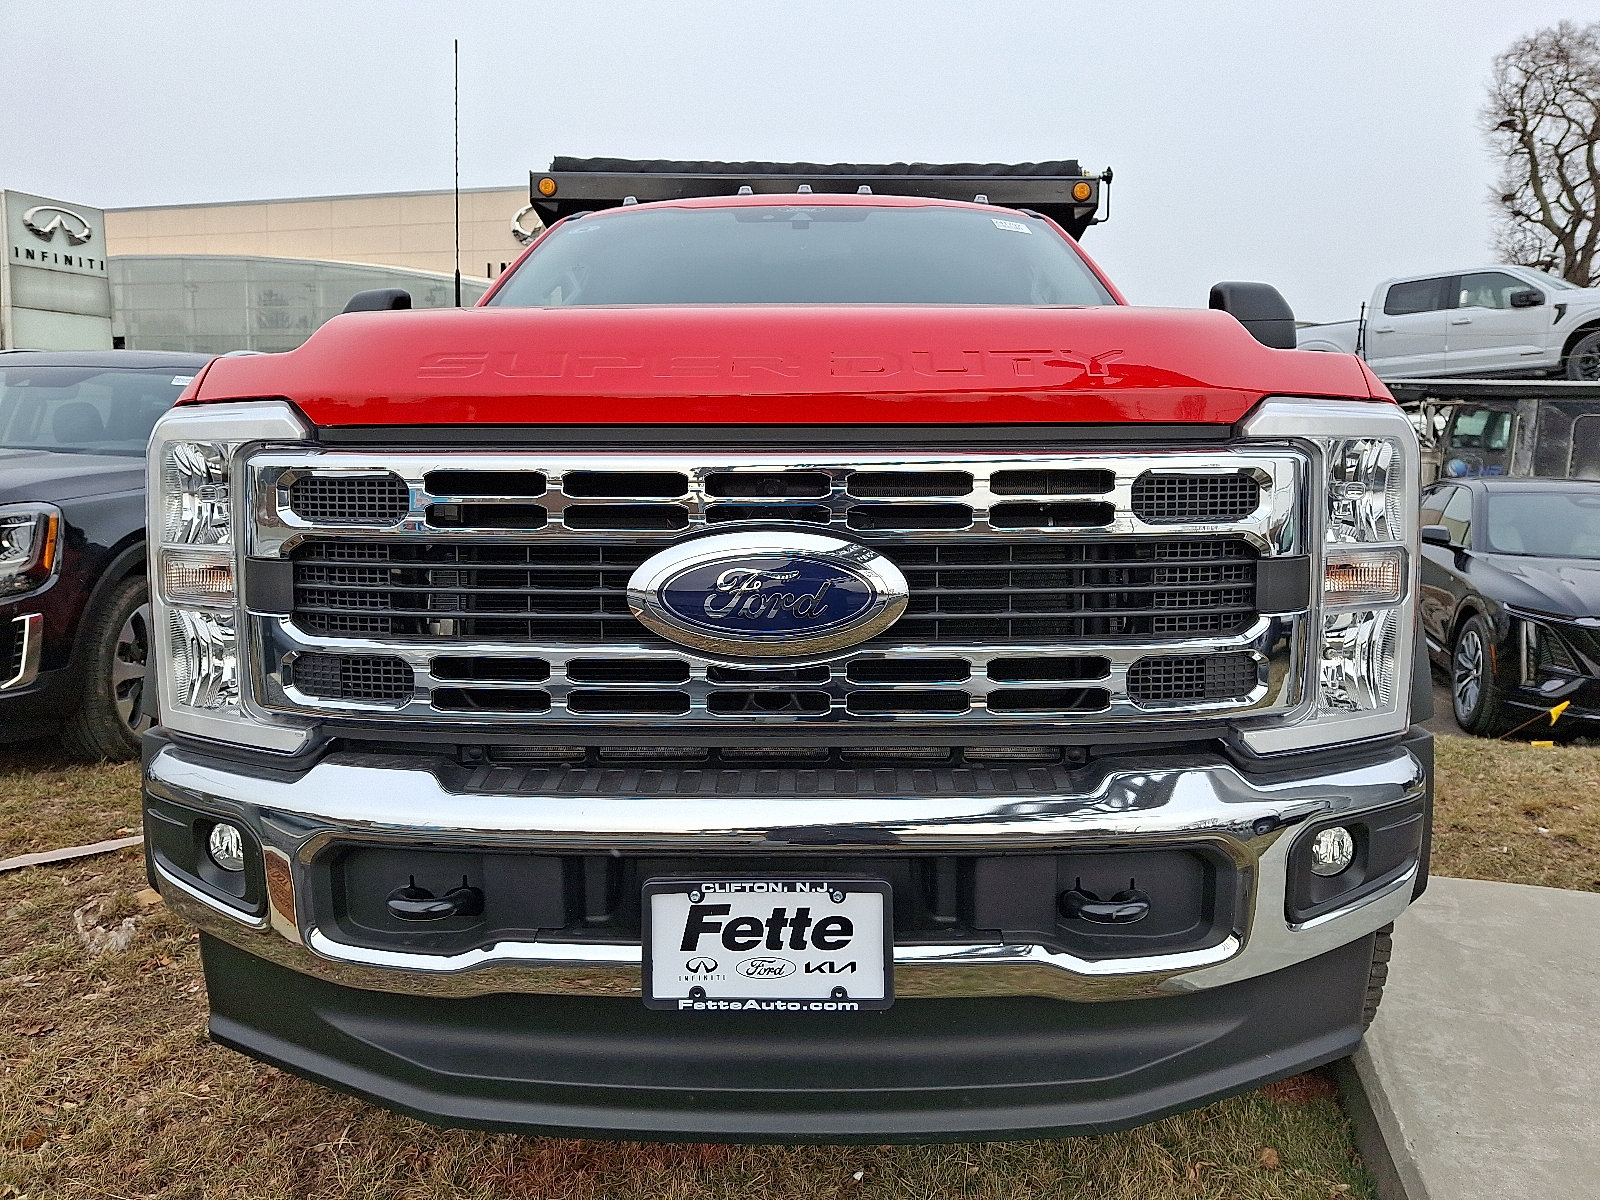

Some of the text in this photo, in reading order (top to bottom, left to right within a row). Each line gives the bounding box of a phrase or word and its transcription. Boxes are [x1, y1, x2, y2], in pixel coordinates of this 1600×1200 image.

[14, 246, 104, 271] INFINITI
[417, 349, 1124, 379] SUPER DUTY
[703, 567, 831, 619] Ford
[701, 882, 834, 893] CLIFTON, N.J.
[679, 903, 854, 952] Fette
[678, 959, 857, 982] INFINITI Ford KIA
[678, 999, 859, 1011] FetteAuto.com
